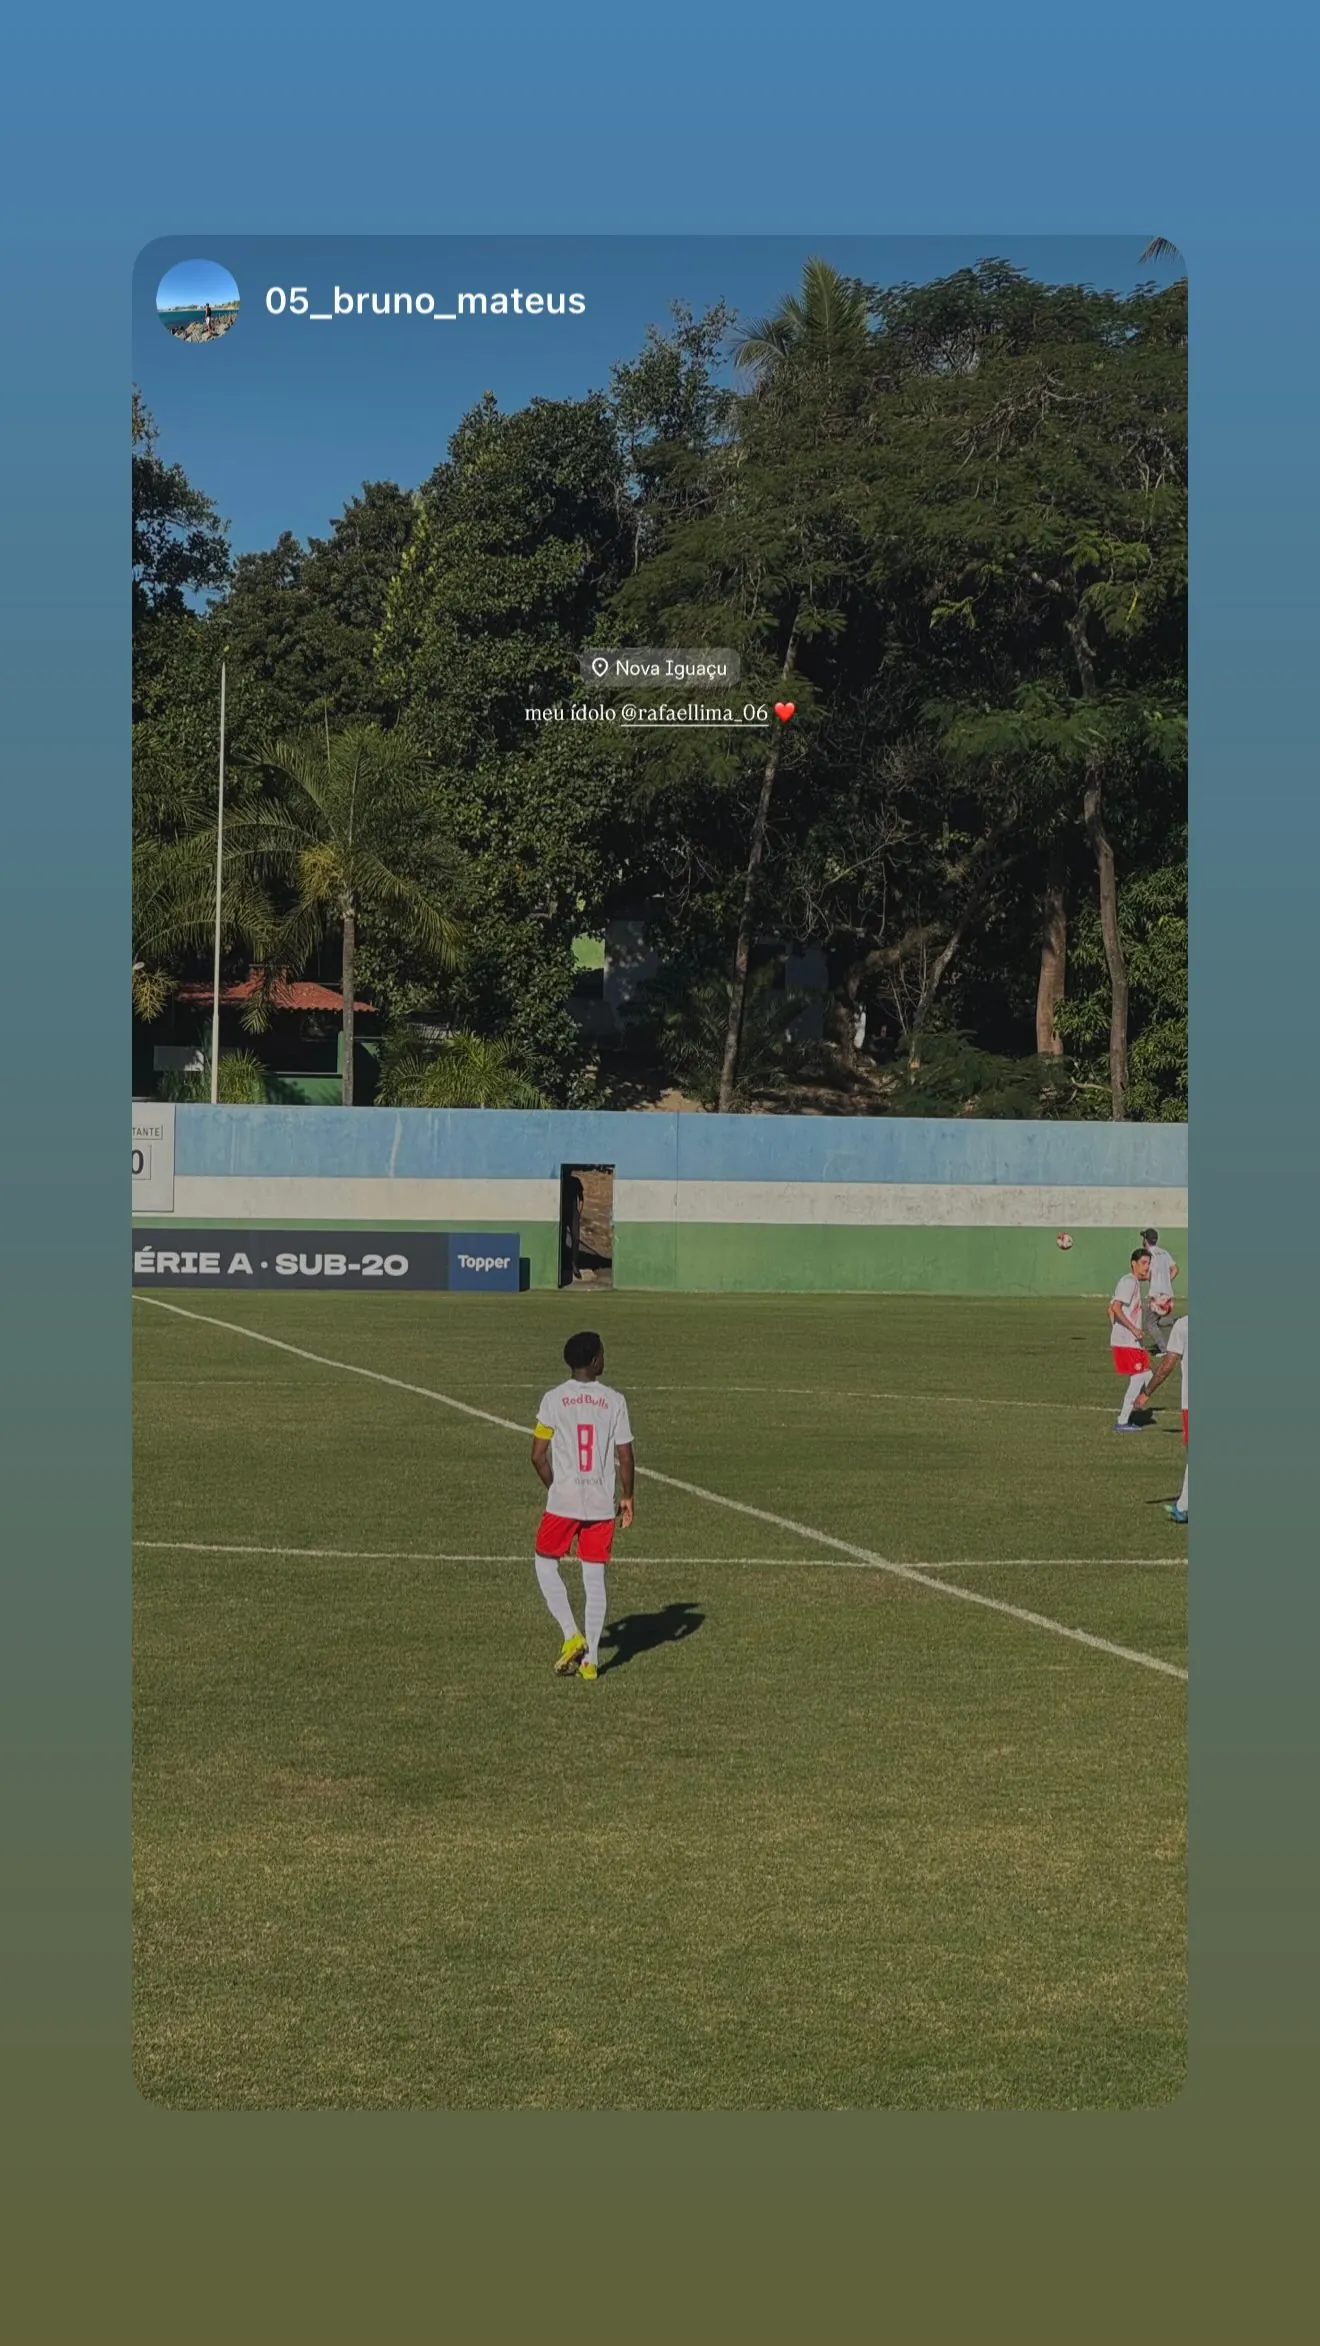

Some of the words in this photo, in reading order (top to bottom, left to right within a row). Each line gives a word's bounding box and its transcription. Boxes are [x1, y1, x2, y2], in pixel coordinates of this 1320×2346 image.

[227, 1252, 254, 1275] A
[275, 1253, 409, 1276] SUB-20
[457, 1254, 511, 1272] Topper
[577, 1424, 594, 1472] 8
